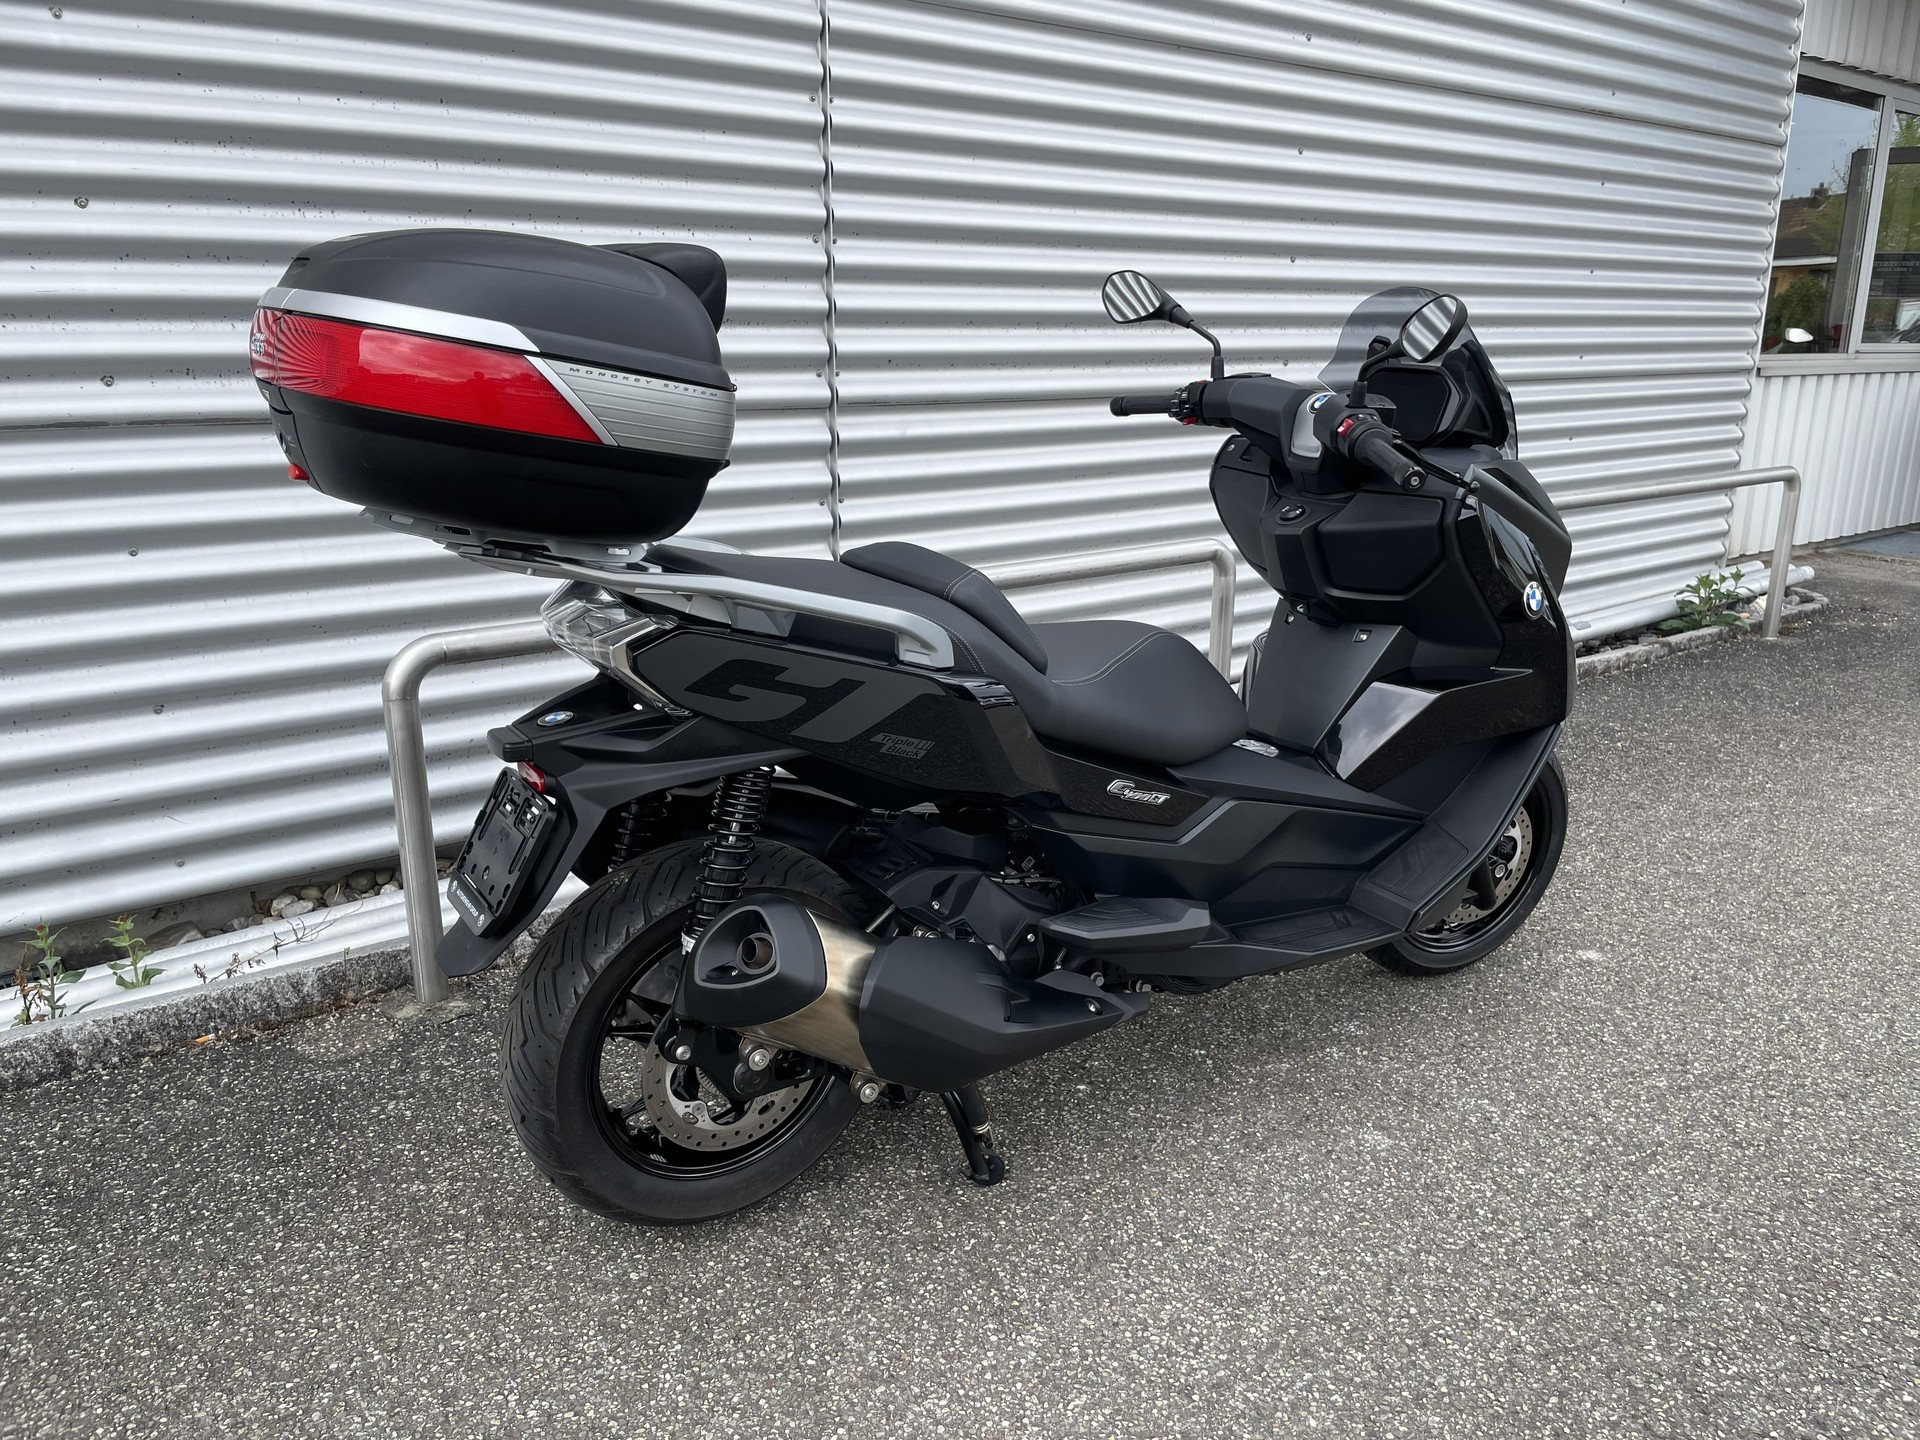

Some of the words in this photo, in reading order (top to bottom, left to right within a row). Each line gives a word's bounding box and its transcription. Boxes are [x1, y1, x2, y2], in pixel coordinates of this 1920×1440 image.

[569, 367, 653, 385] MONOKEY
[663, 383, 718, 398] SYSTEM
[880, 734, 915, 747] Triple
[885, 746, 921, 758] Black
